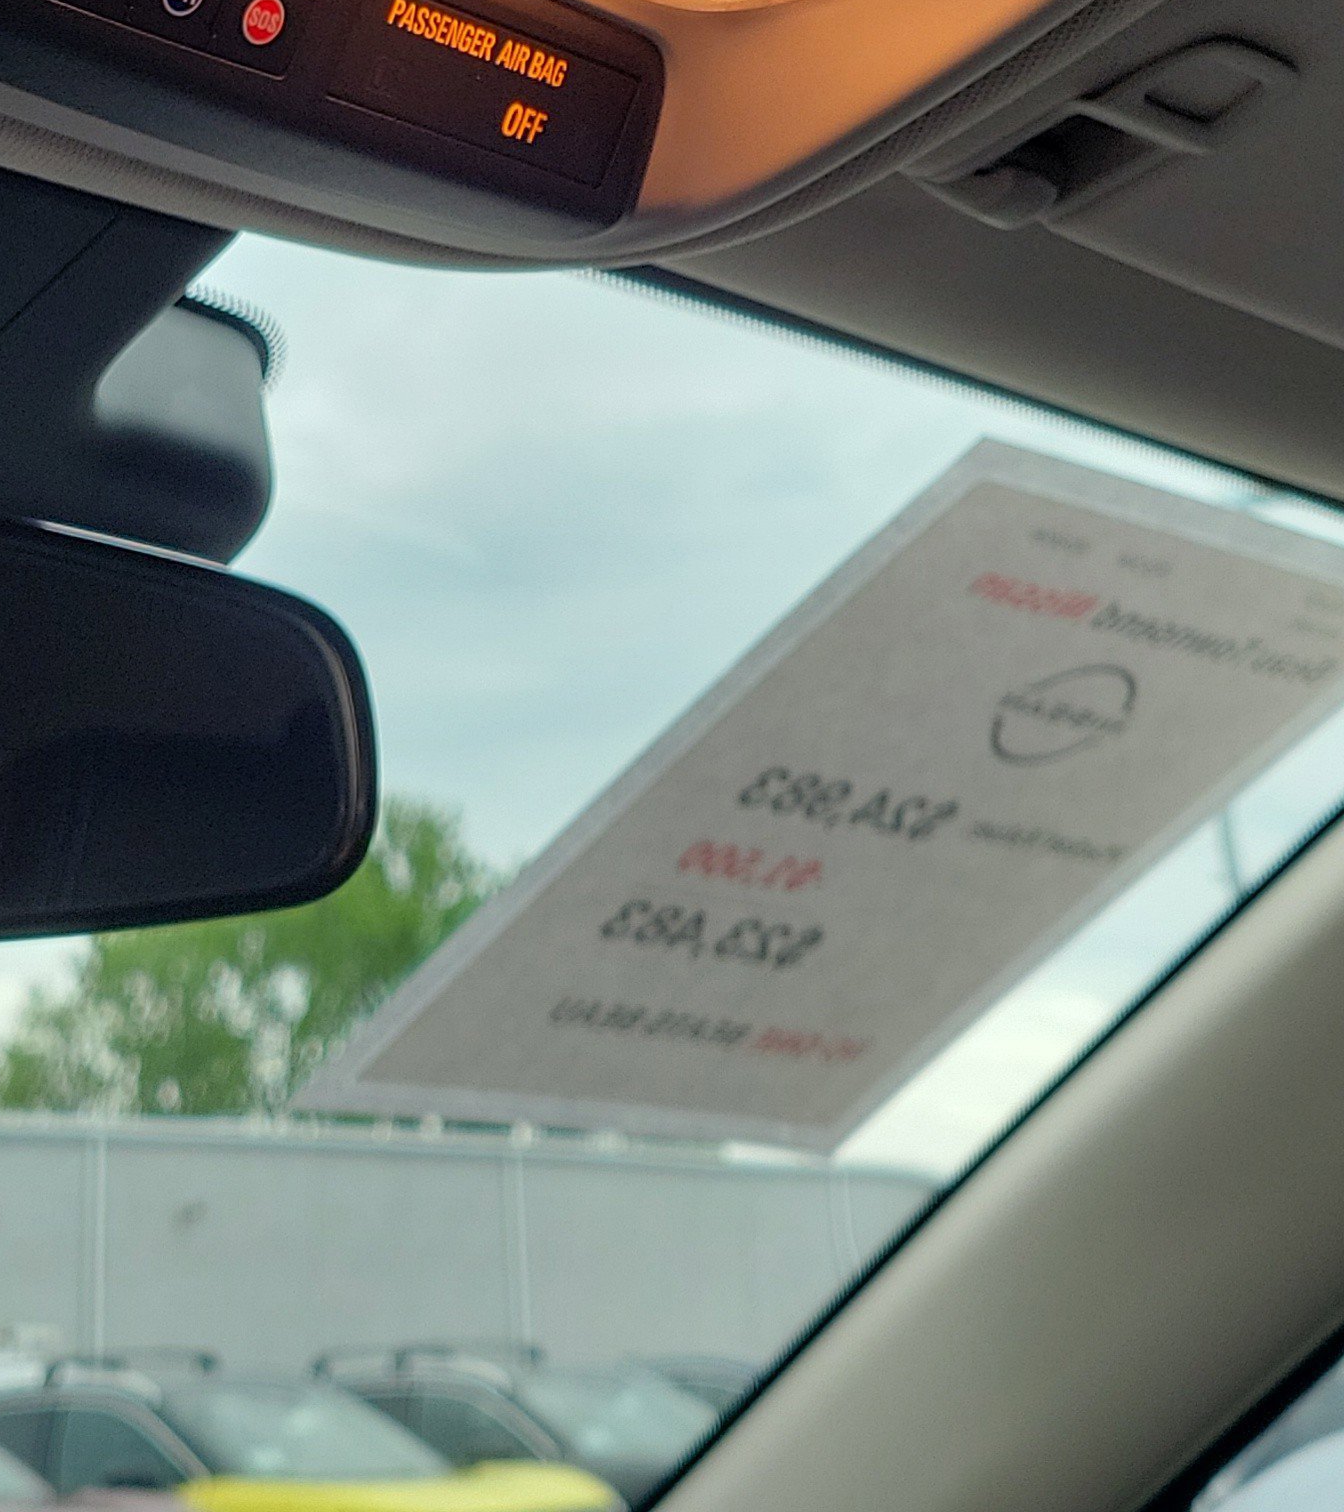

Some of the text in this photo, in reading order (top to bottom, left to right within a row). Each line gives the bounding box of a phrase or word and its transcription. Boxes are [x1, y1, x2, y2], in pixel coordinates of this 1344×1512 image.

[247, 6, 280, 34] SOS
[494, 38, 531, 76] AIR
[527, 48, 568, 88] BAG
[501, 101, 549, 144] OFF
